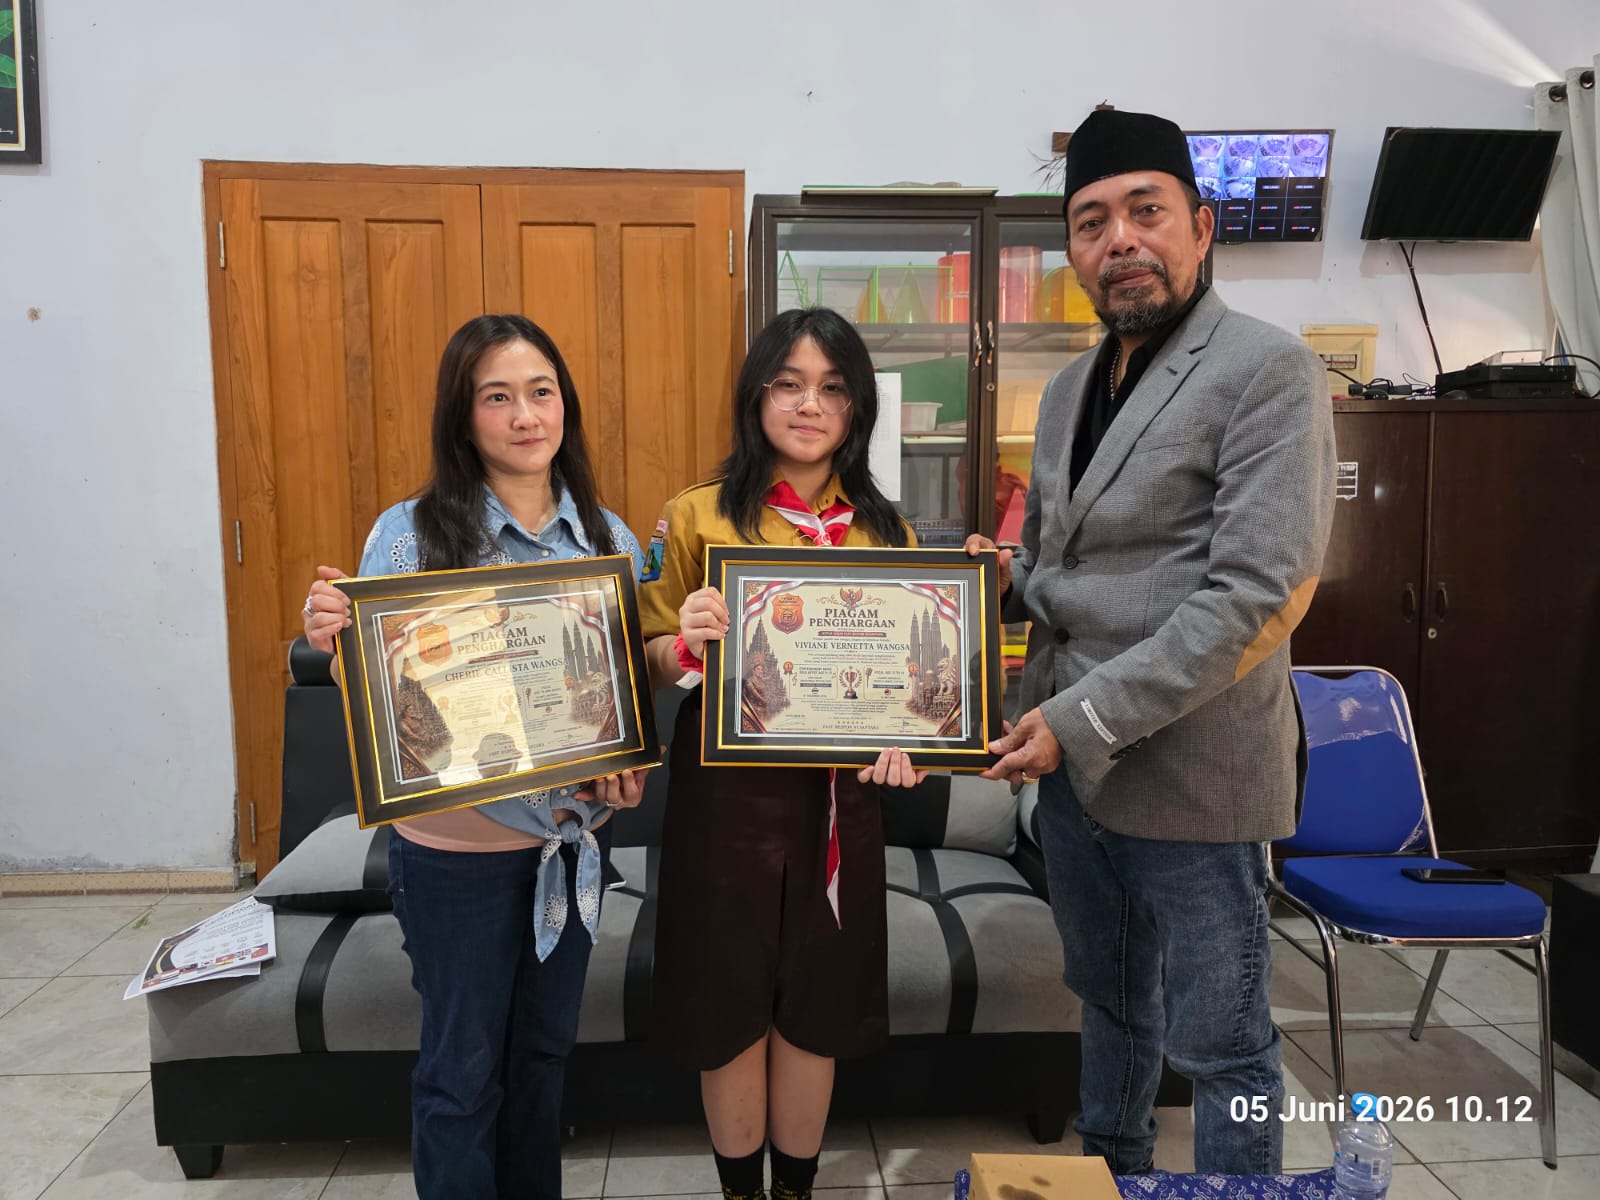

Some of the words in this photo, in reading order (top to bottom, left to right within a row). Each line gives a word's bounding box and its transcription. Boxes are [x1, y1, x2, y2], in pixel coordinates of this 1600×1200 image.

[824, 608, 878, 619] PIAGAM
[809, 618, 896, 628] PENGHARGAAN
[471, 626, 528, 643] PIAGAM
[457, 635, 546, 655] PENGHARGAAN
[794, 641, 828, 650] VIVIANE
[831, 642, 874, 651] VERNETTA
[876, 643, 910, 651] WANGSA
[444, 669, 482, 682] CHERIE
